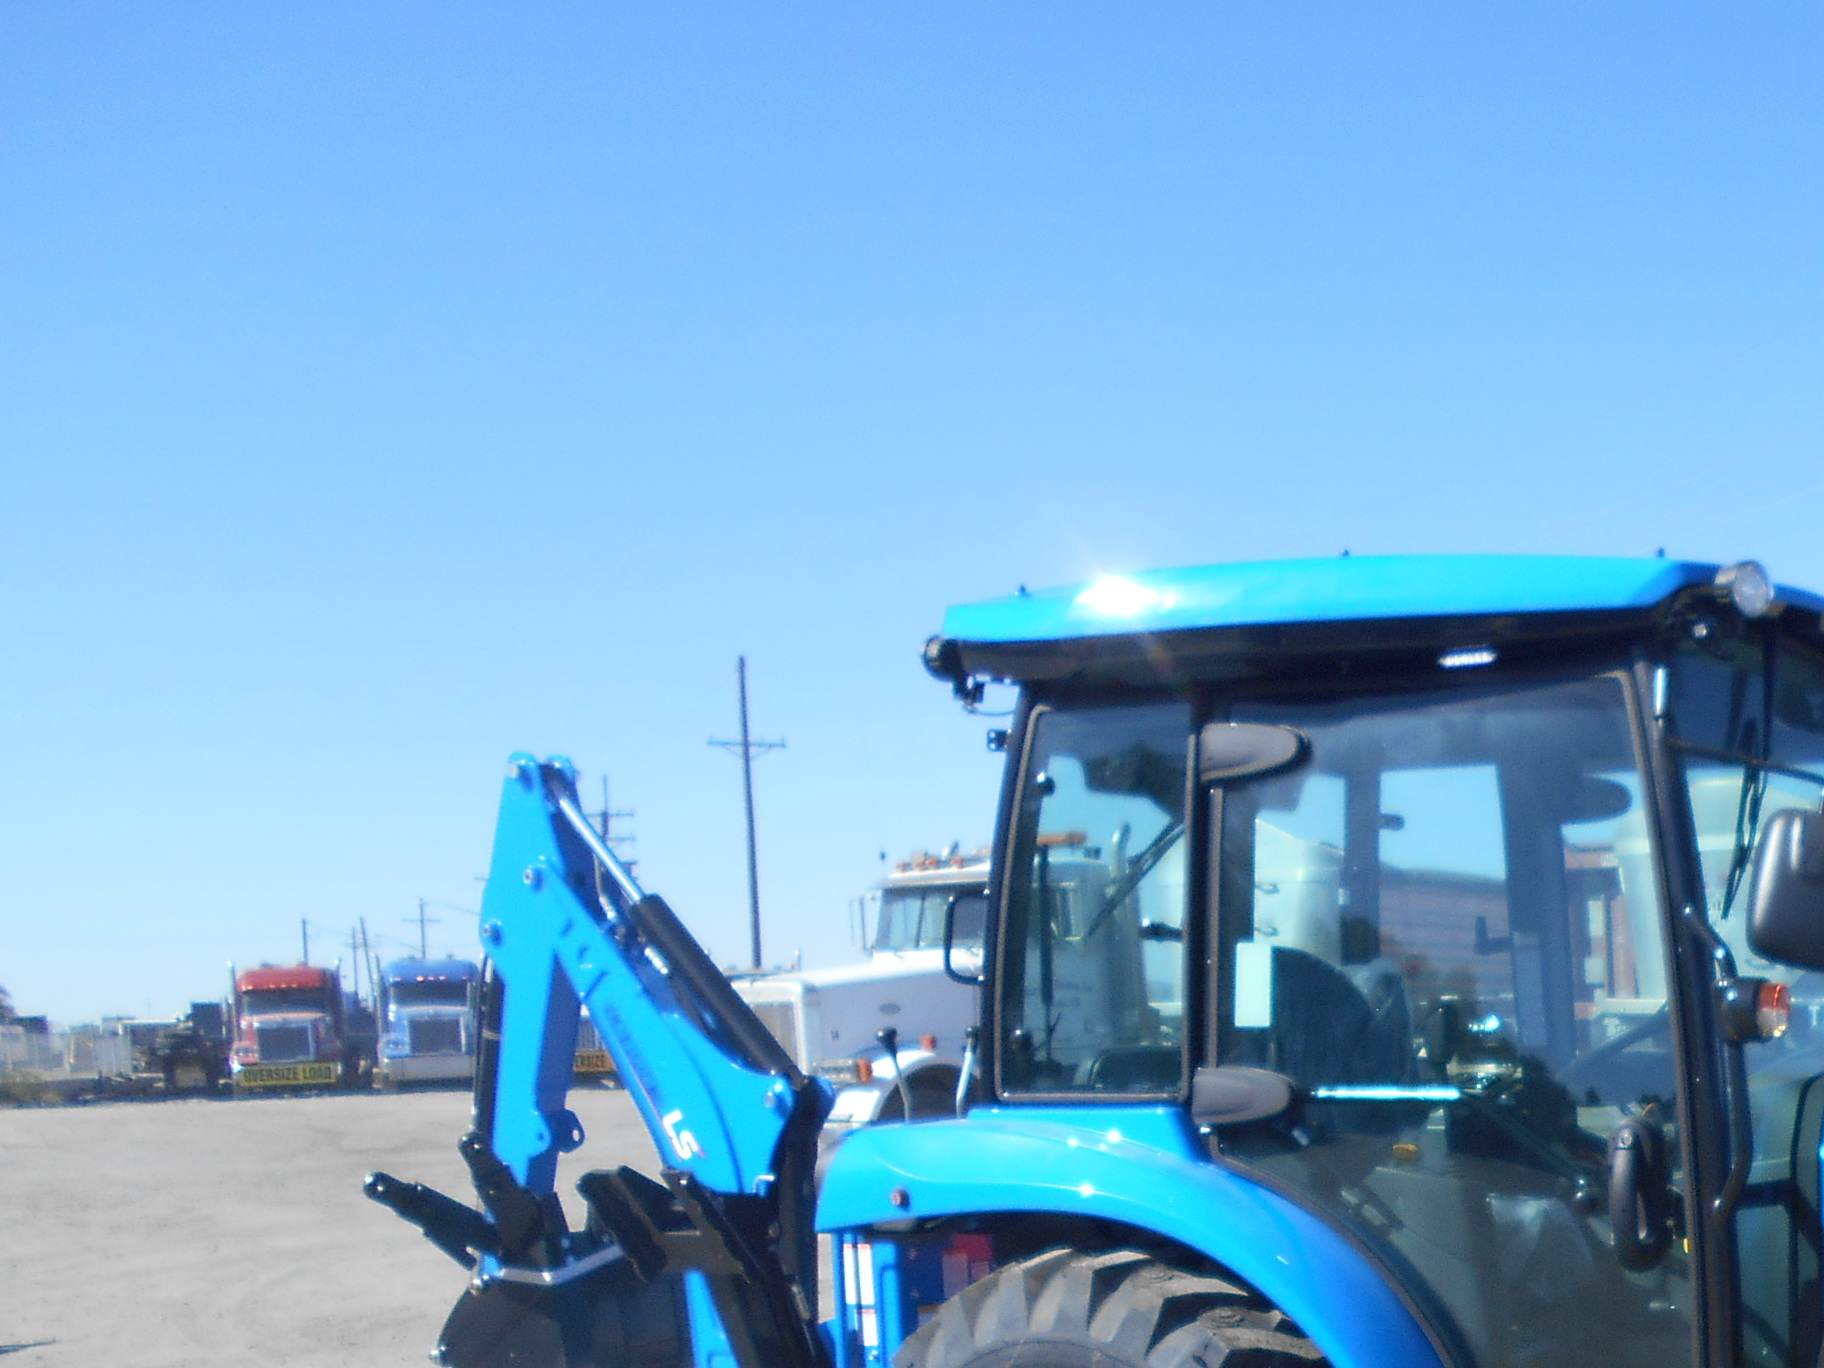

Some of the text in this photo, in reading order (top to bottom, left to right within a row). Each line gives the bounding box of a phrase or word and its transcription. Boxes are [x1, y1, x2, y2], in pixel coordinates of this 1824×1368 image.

[244, 1065, 332, 1082] OVERSIZE LOAD
[662, 1109, 700, 1160] LS
